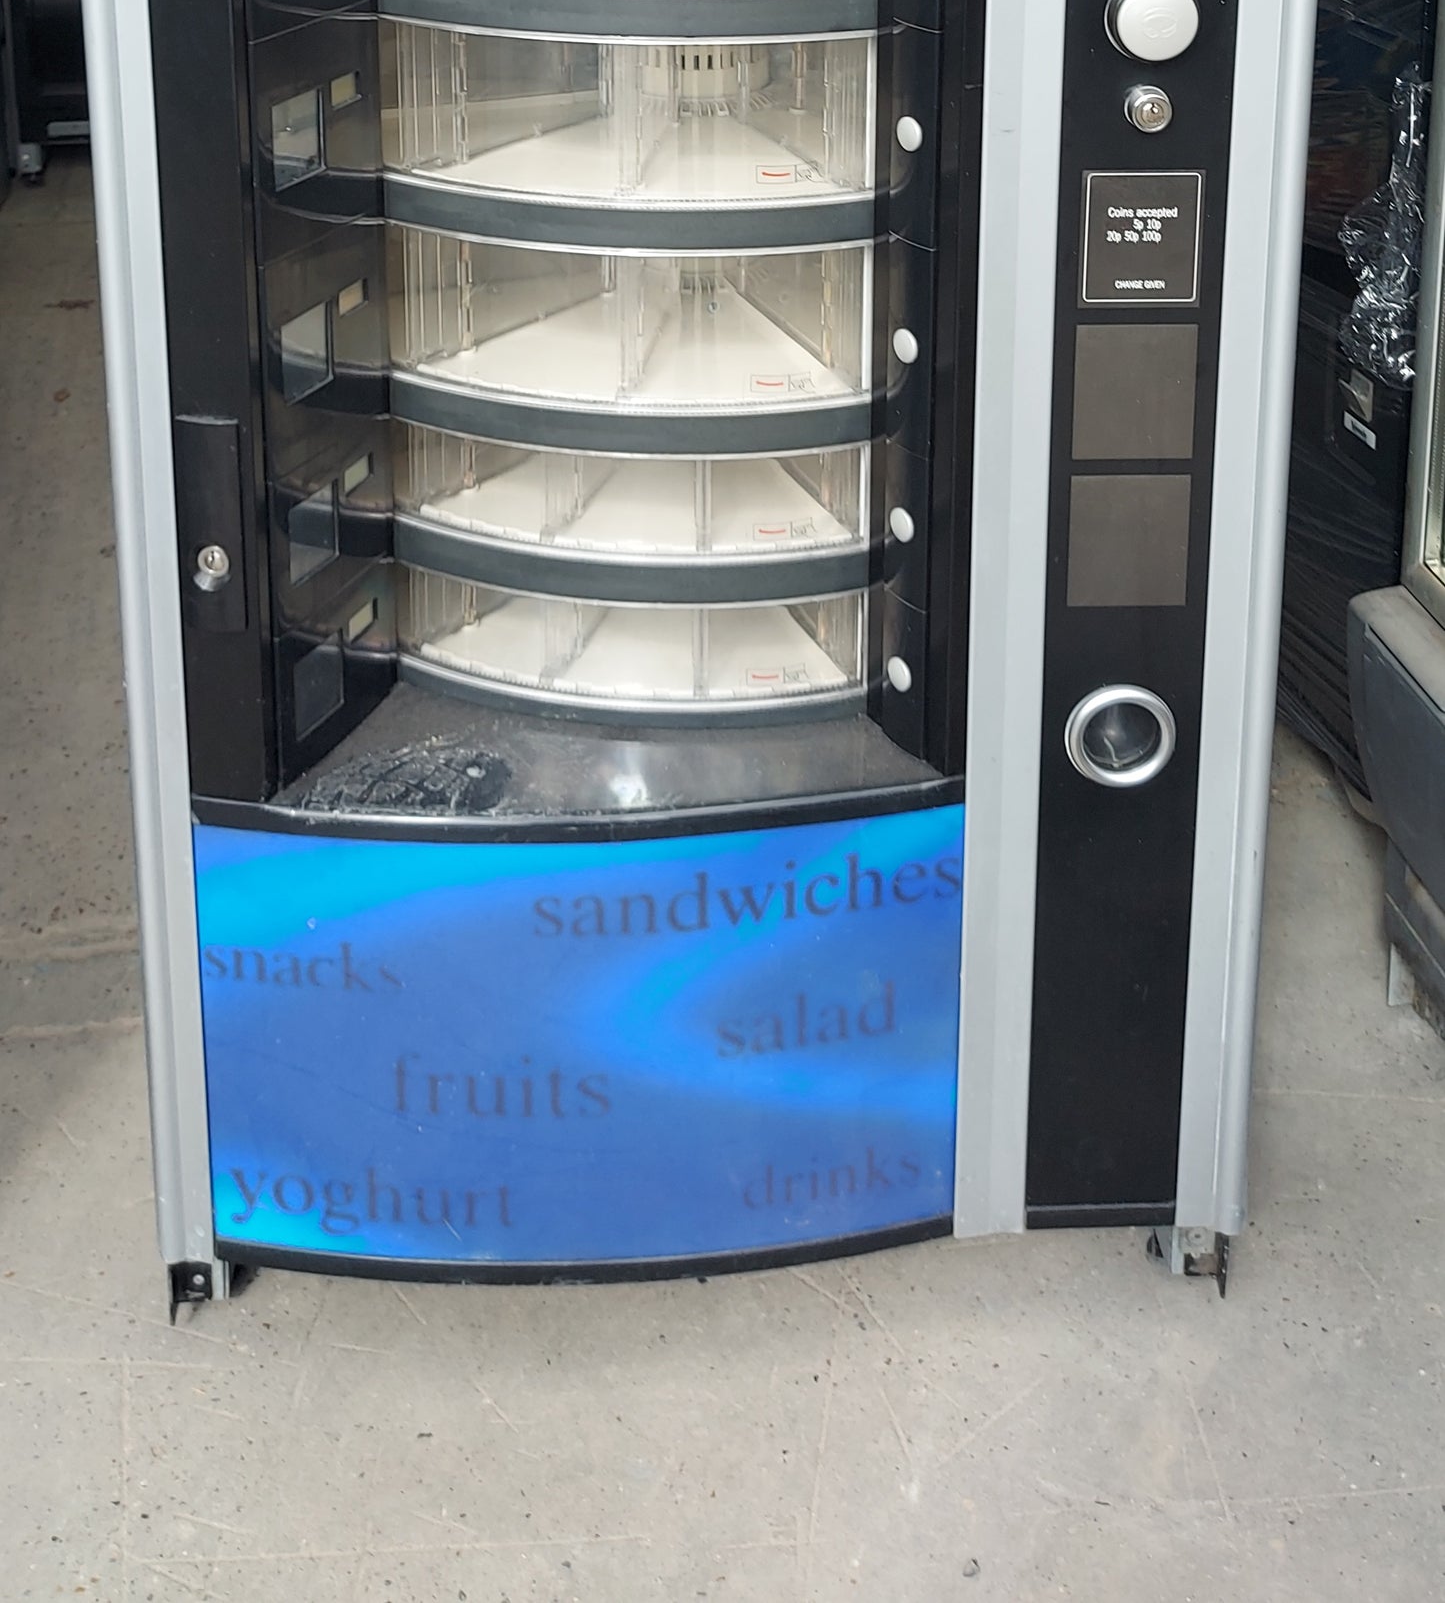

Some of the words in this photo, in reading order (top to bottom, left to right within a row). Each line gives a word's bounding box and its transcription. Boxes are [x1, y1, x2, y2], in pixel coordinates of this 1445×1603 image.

[1106, 230, 1122, 243] 20p
[1124, 230, 1139, 243] 50p
[1142, 230, 1162, 243] 100p
[1108, 207, 1134, 218] Coins
[1136, 207, 1178, 219] accepted
[1133, 219, 1144, 231] 5p
[1147, 219, 1162, 231] 10p
[1114, 280, 1144, 289] CHANGE
[1144, 280, 1165, 289] GIVEN
[532, 851, 962, 939] sandwiches
[203, 940, 403, 993] snacks
[716, 973, 896, 1059] salad
[393, 1053, 612, 1119] fruits
[230, 1165, 514, 1235] yoghurt
[742, 1145, 922, 1211] drinks
